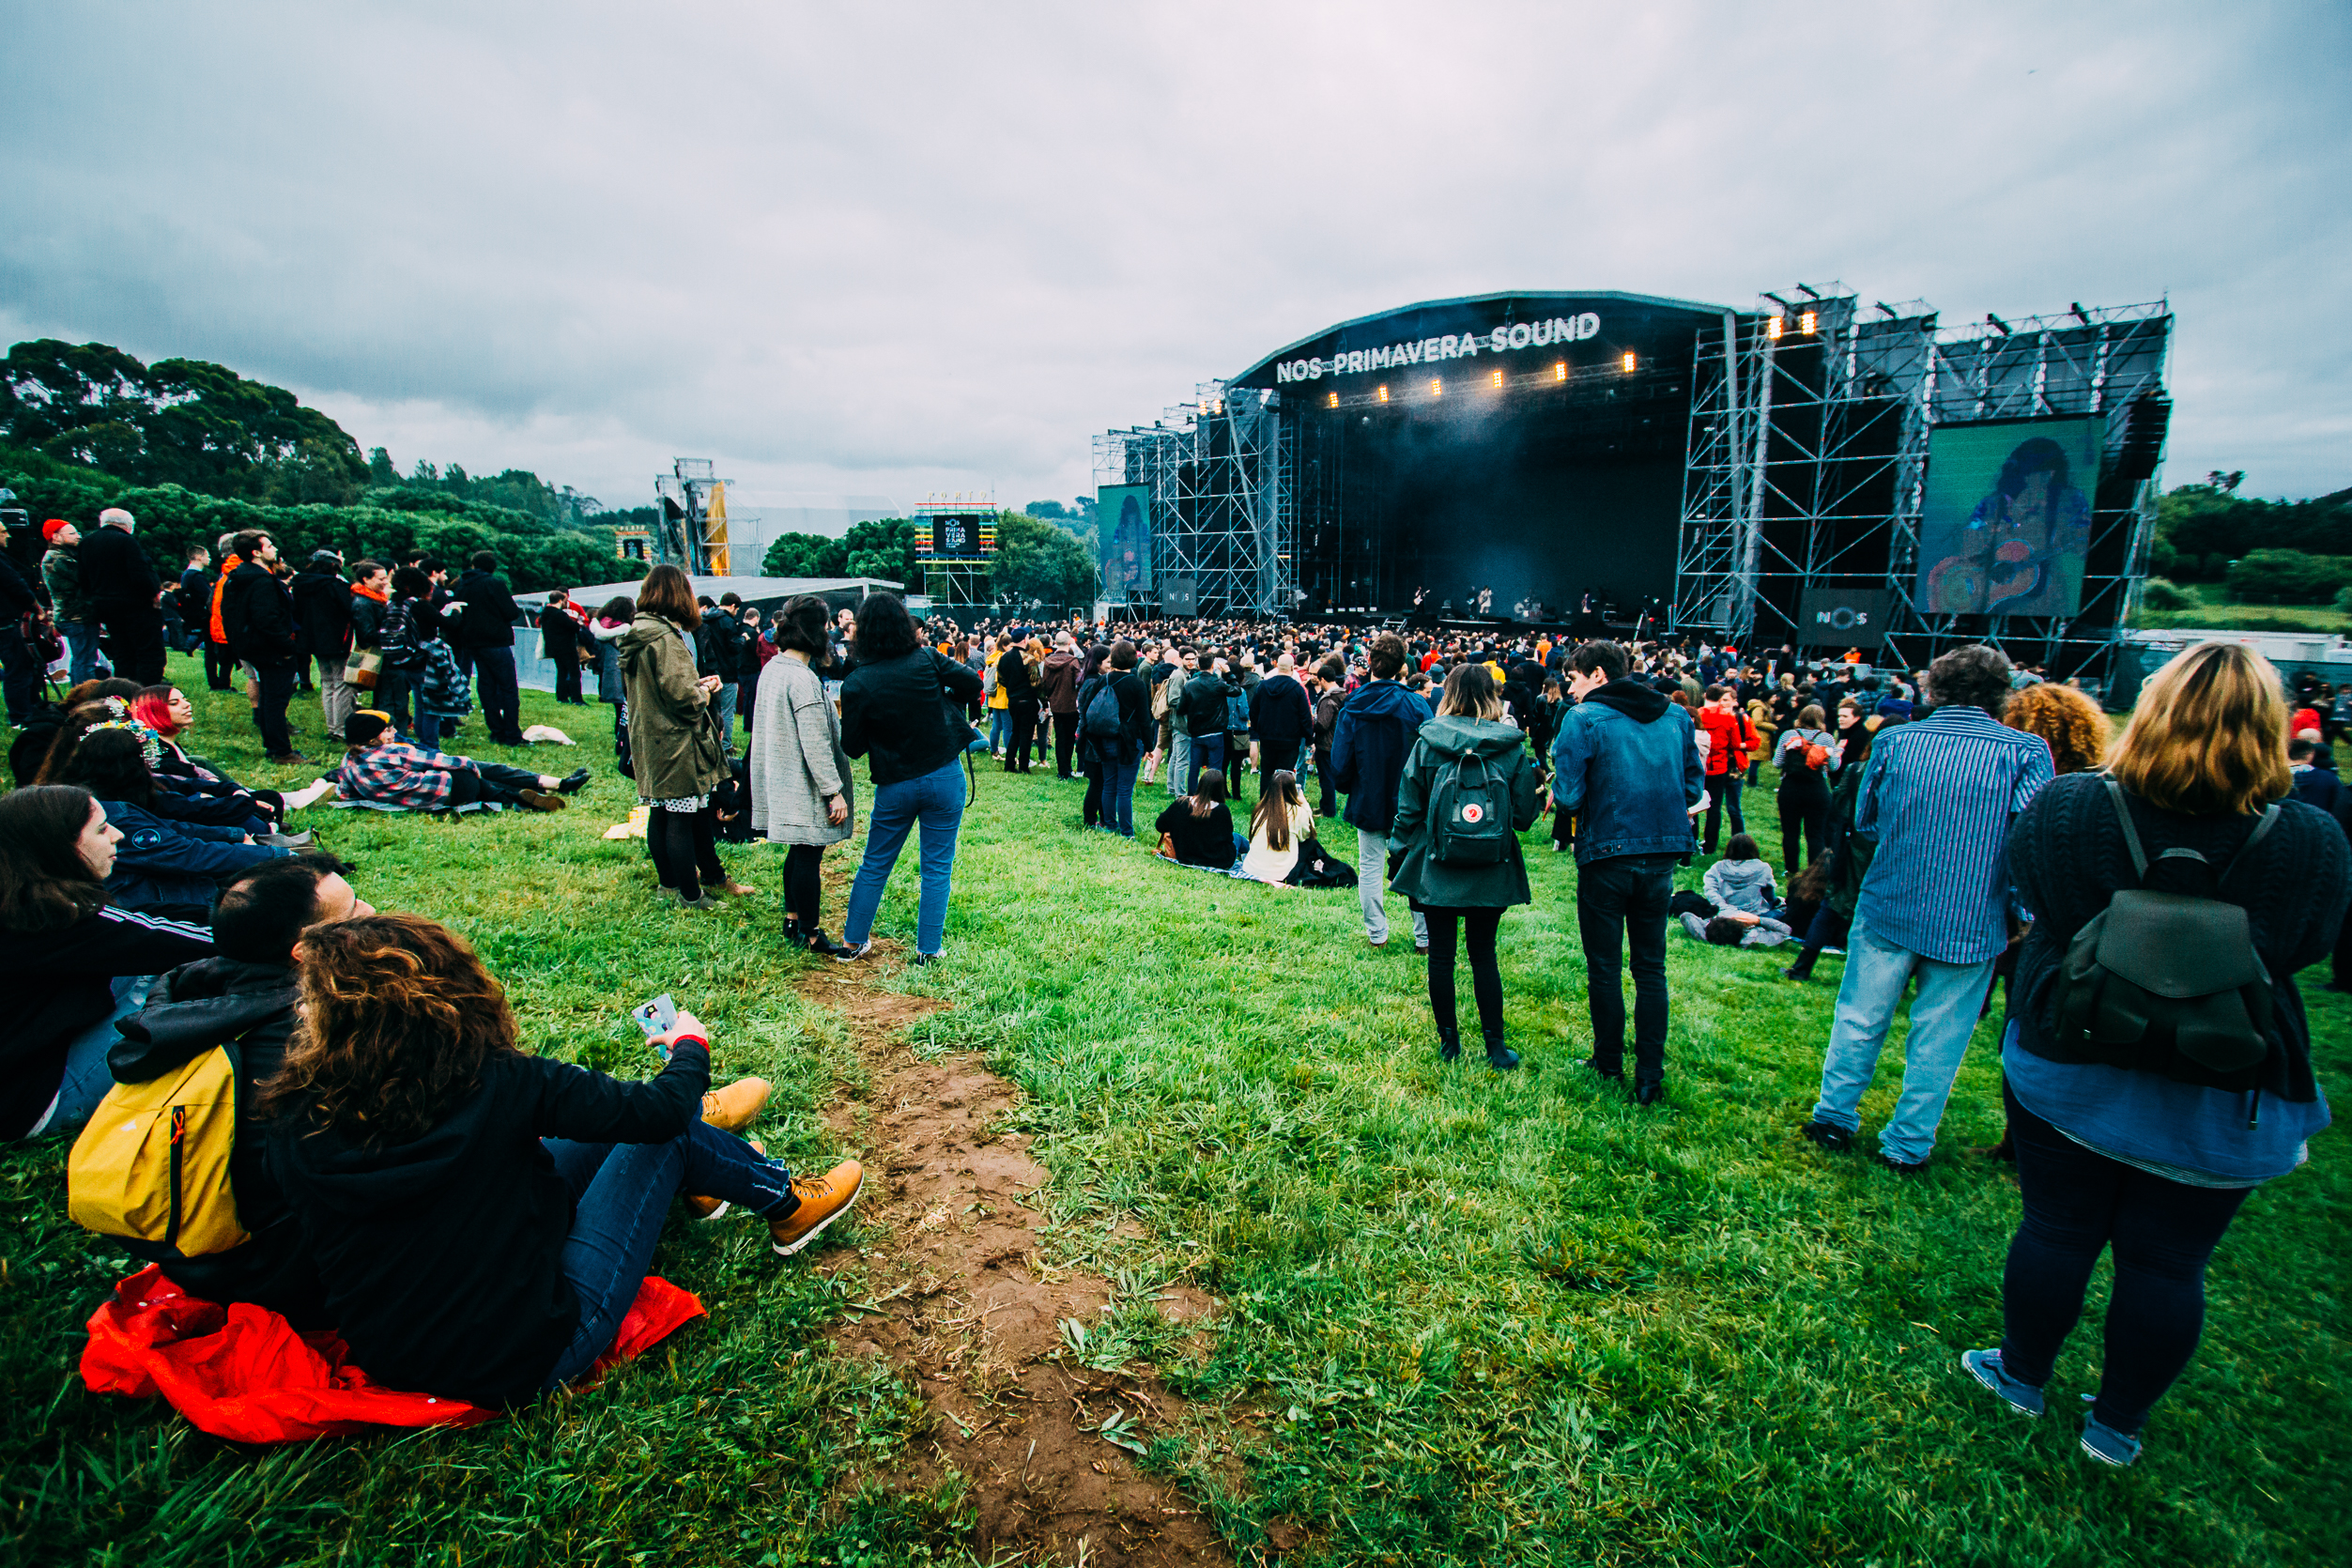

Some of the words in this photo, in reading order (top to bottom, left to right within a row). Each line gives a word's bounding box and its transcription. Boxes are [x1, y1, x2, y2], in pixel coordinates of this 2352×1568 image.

[1277, 358, 1322, 384] NOS
[1334, 331, 1478, 376] PRIMAVERA
[1491, 312, 1600, 353] SOUND
[927, 491, 987, 500] PORTO
[1169, 591, 1190, 603] NOS
[1816, 607, 1868, 629] NOS
